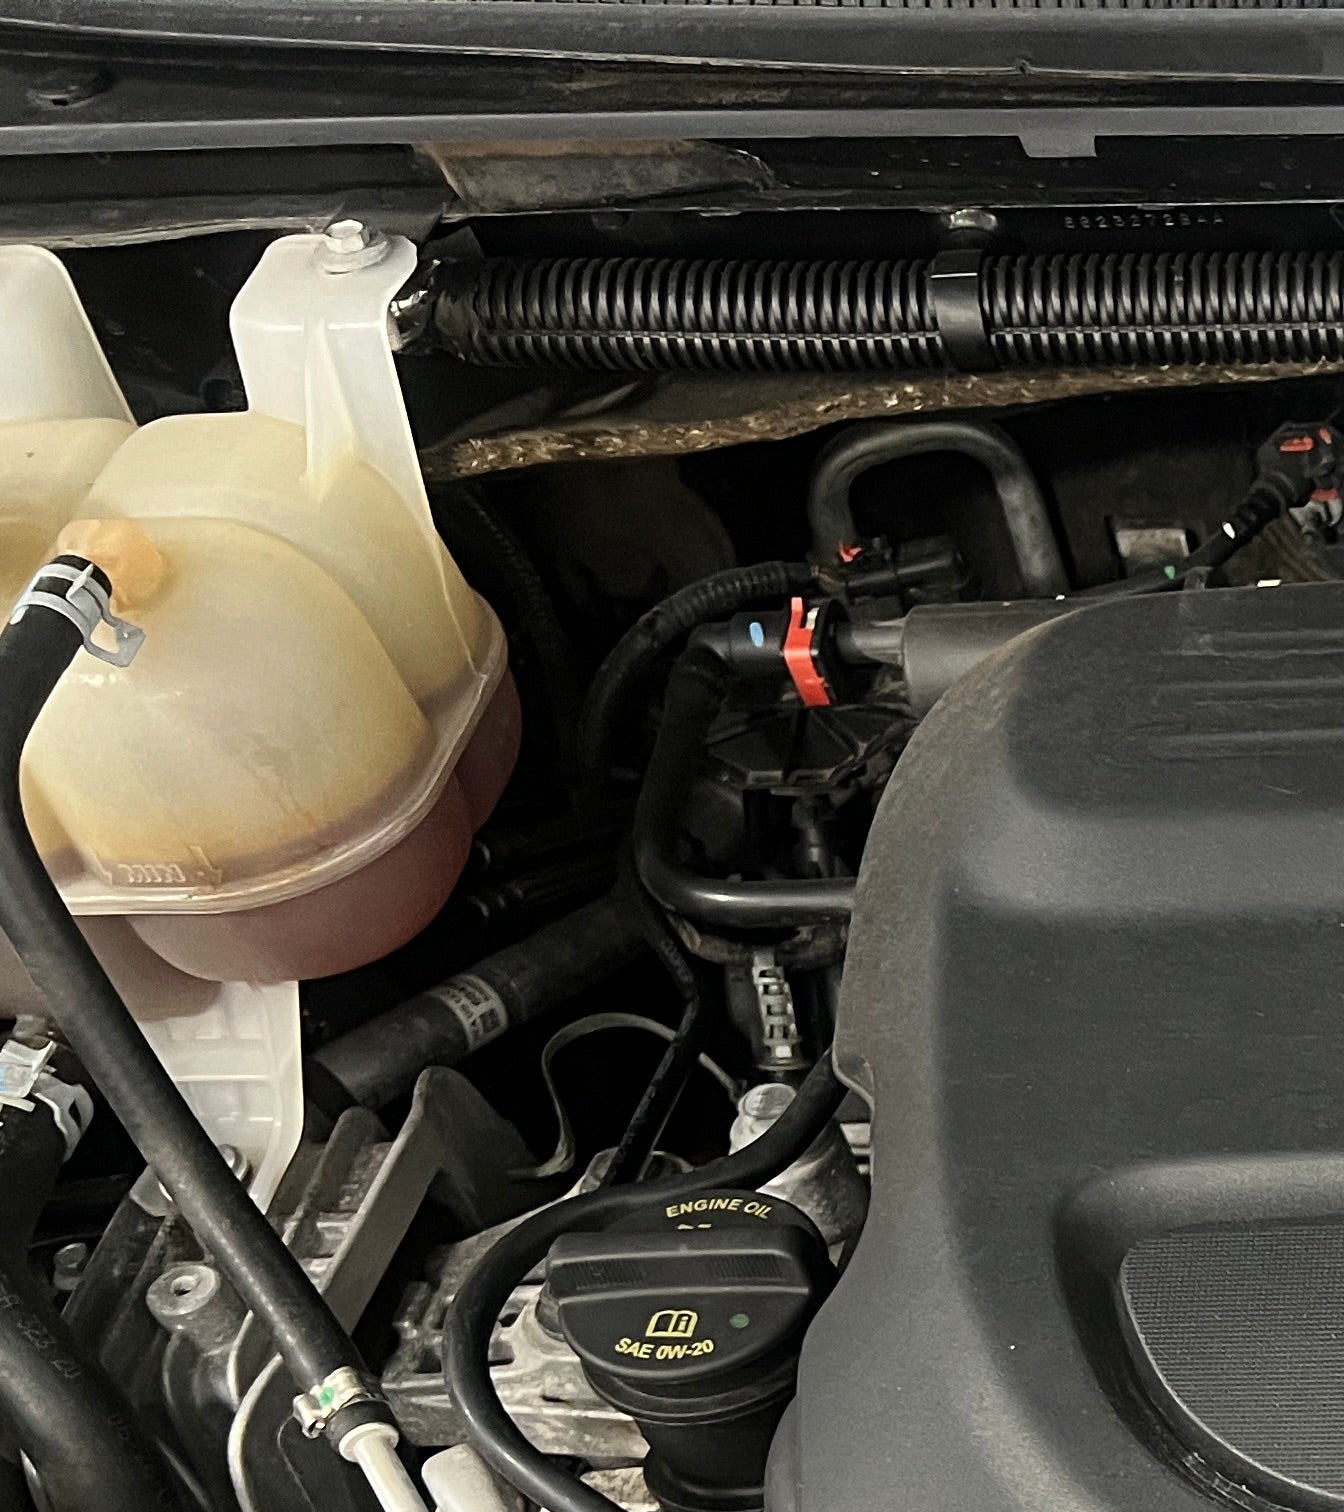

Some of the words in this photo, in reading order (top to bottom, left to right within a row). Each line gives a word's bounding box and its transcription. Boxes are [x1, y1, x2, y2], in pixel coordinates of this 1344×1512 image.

[665, 1197, 743, 1218] ENGINE
[742, 1200, 774, 1220] OIL
[614, 1337, 654, 1360] SAE
